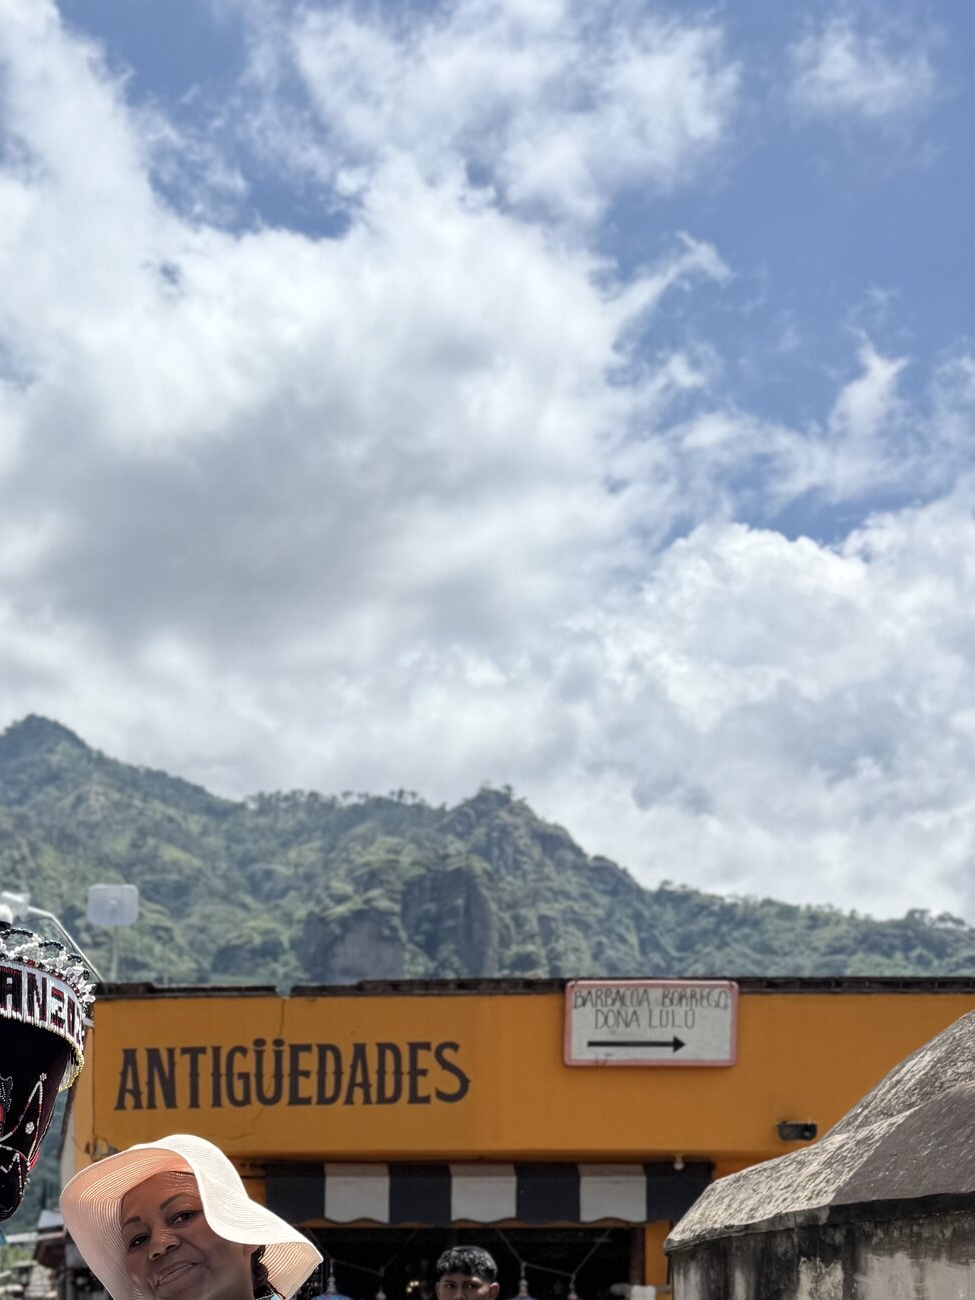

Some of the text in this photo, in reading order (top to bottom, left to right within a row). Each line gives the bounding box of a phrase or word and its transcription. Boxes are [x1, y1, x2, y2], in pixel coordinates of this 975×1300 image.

[574, 988, 729, 1010] BARBACOA BORREGO
[113, 1038, 471, 1111] ANTIGÜEDADES
